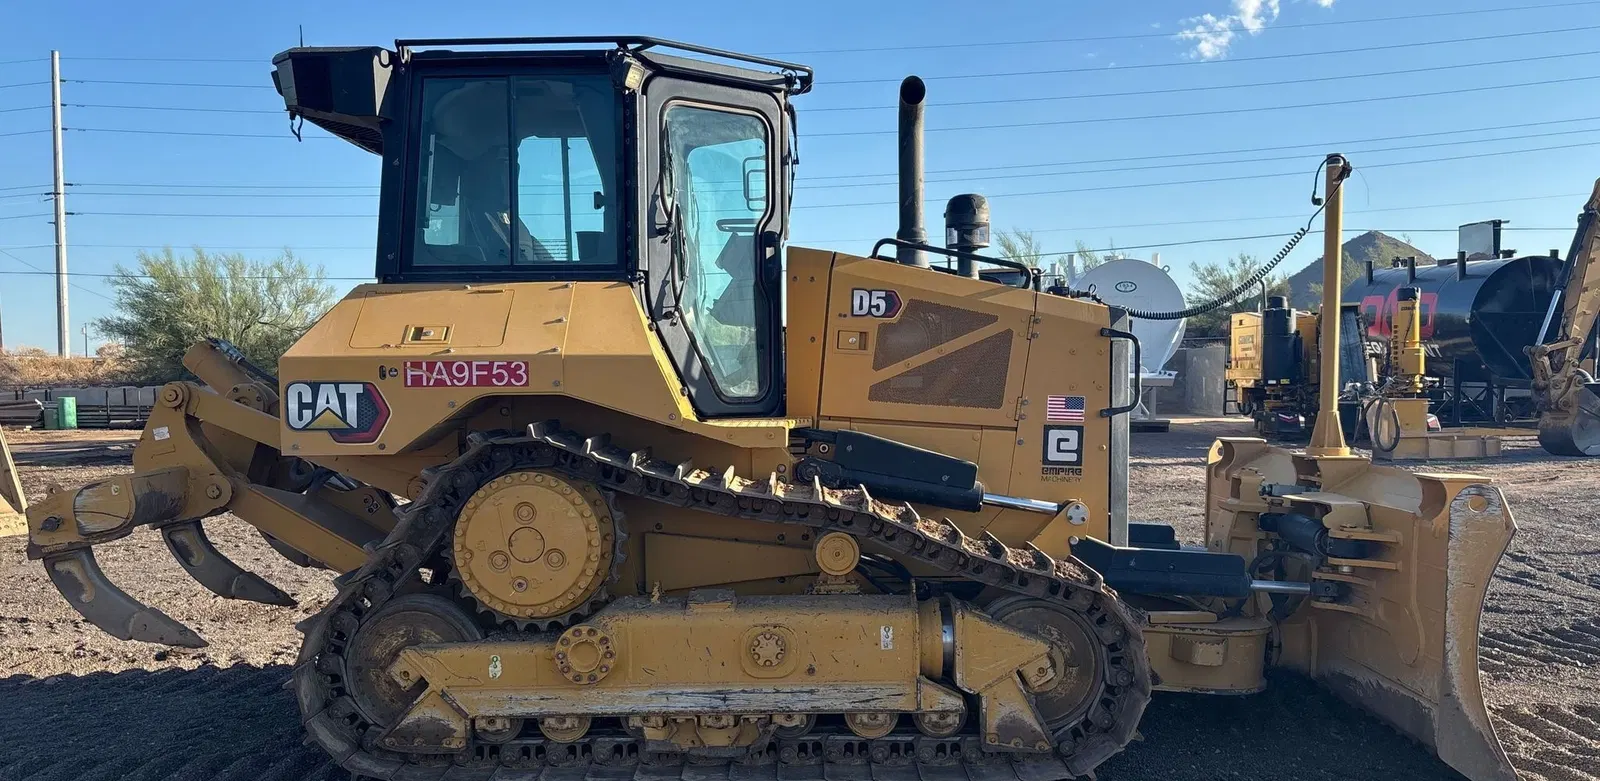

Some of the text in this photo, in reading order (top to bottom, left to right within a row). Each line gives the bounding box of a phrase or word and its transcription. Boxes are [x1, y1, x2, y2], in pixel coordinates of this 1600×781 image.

[853, 289, 886, 316] D5
[406, 361, 528, 386] HA9F53
[287, 383, 363, 429] CAT
